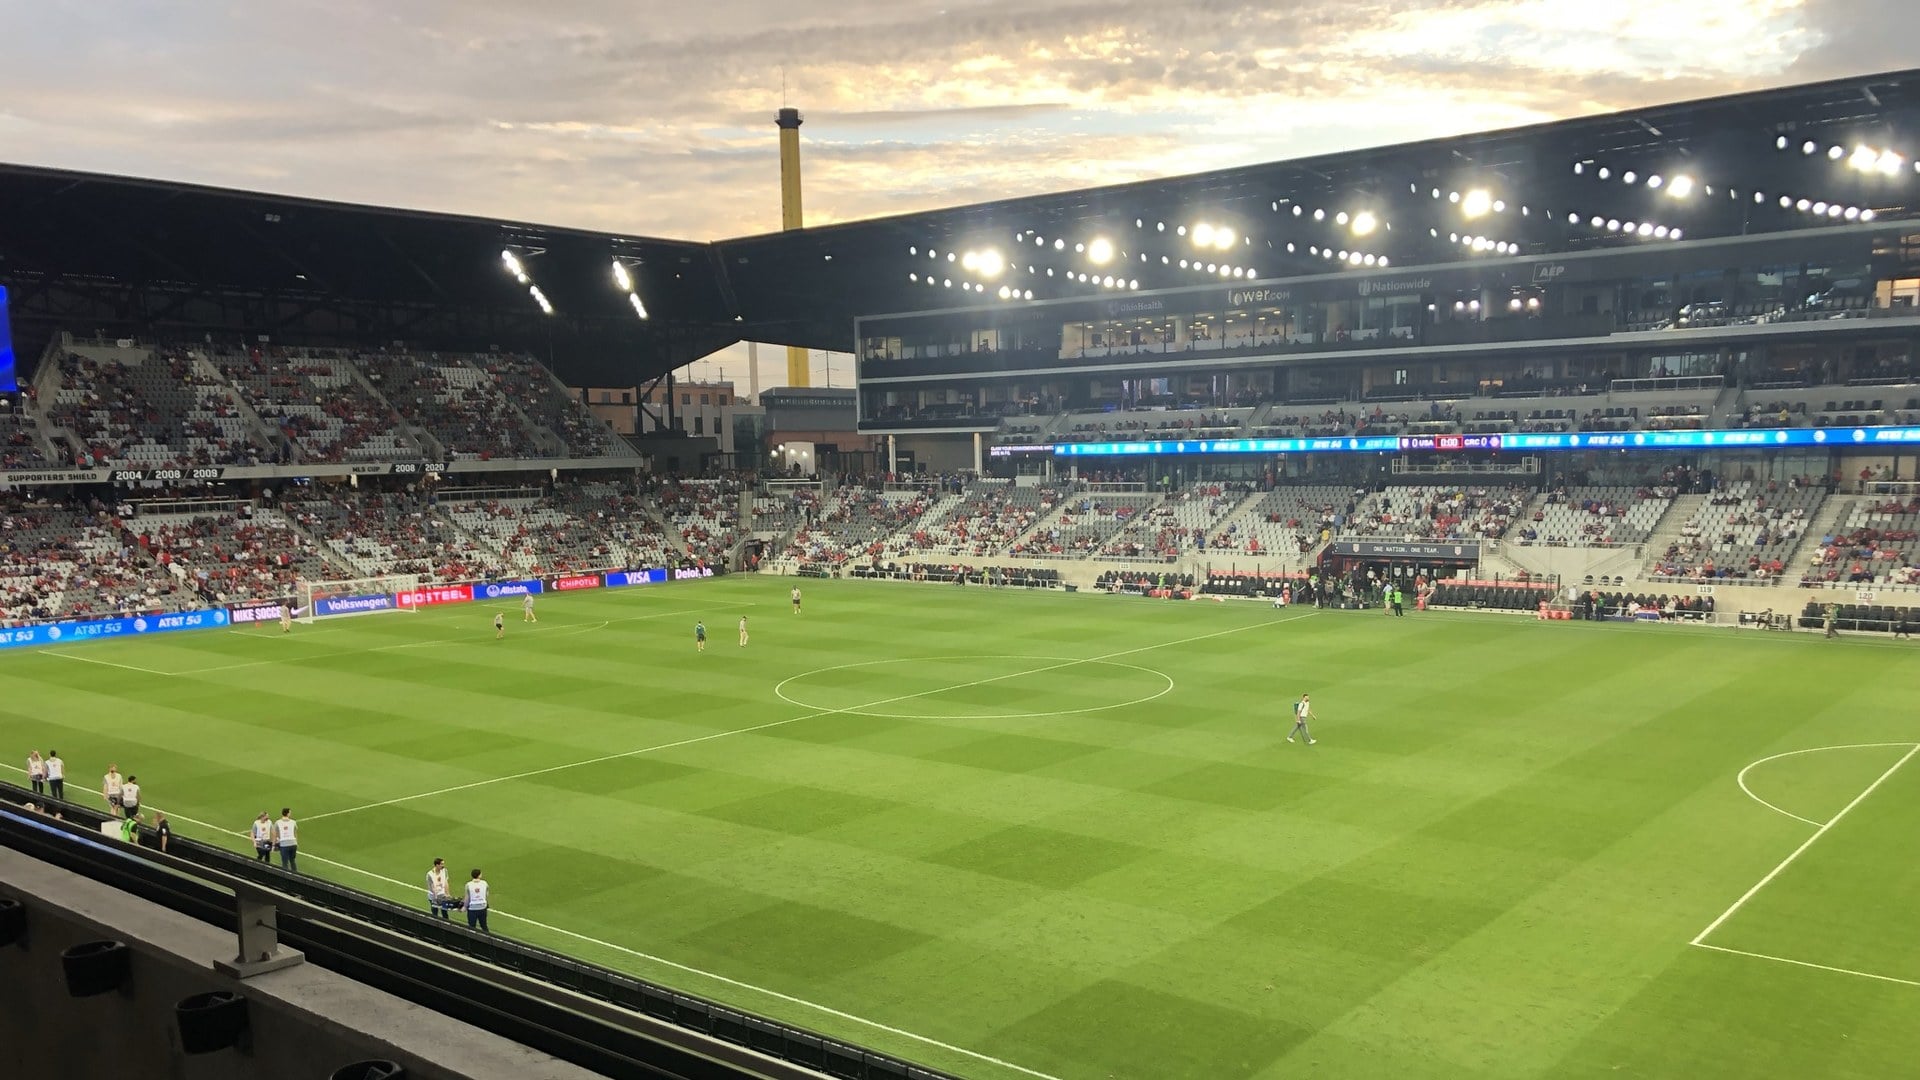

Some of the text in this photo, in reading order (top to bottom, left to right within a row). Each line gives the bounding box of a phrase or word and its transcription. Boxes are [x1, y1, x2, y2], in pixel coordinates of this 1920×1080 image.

[1539, 266, 1565, 277] AEP
[1372, 277, 1431, 292] Nationwide
[1411, 438, 1434, 448] 0 USA
[1440, 438, 1458, 447] 0:00
[1464, 437, 1488, 447] CRC 0
[395, 464, 416, 473] 2008
[424, 463, 445, 472] 2020
[7, 472, 97, 482] SUPPORTERS' SHIELD
[115, 471, 142, 480] 2004
[155, 470, 181, 479] 2008
[624, 571, 651, 584] VISA
[560, 578, 598, 588] CHIPOTLE
[327, 597, 387, 612] Volkswagen
[233, 605, 283, 622] NIKE SOCCE
[158, 614, 203, 628] AT&T 5G
[74, 622, 123, 637] AT&T 5G
[15, 630, 34, 641] 5G
